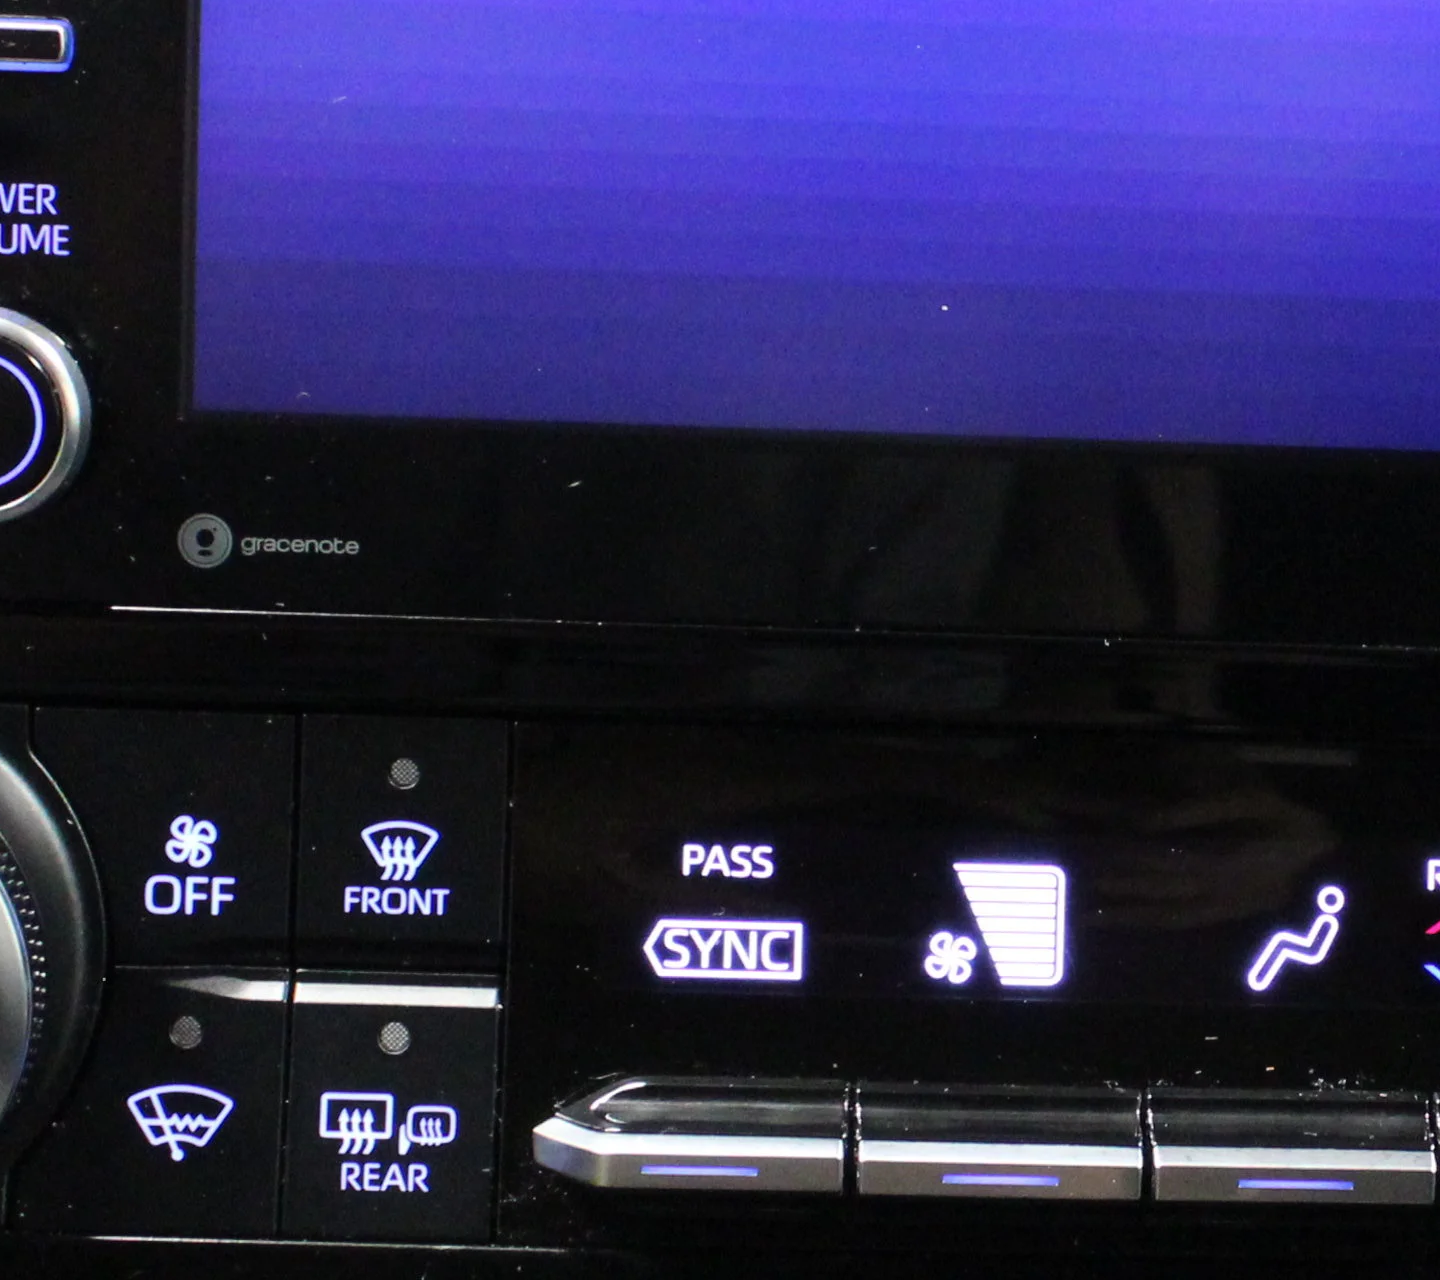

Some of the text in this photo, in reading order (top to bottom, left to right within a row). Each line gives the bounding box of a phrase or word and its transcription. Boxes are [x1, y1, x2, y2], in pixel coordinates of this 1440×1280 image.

[241, 537, 360, 557] gracenote
[681, 842, 774, 879] PASS
[144, 874, 236, 916] OFF
[344, 886, 450, 916] FRONT
[662, 928, 790, 971] SYNC
[340, 1161, 429, 1193] REAR
